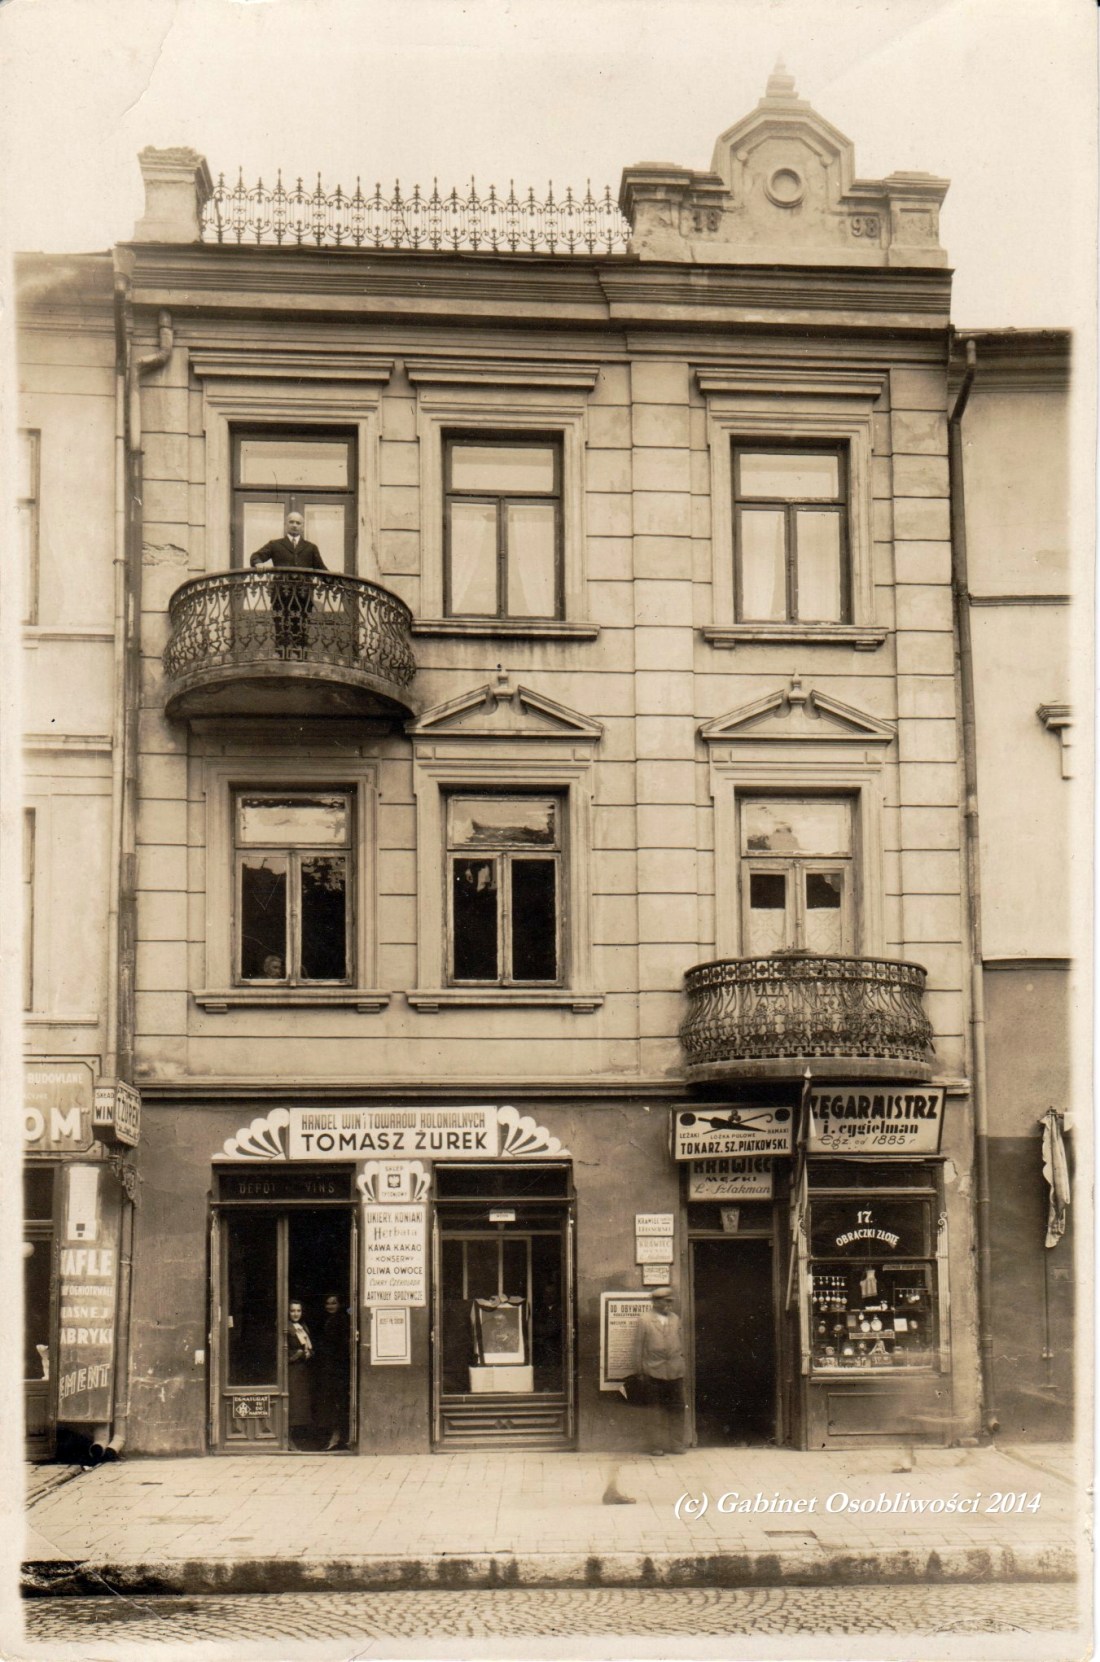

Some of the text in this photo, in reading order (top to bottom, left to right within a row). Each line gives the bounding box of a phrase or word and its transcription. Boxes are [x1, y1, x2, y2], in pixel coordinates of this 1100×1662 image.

[851, 216, 881, 239] 98
[95, 1105, 113, 1120] WIN
[808, 1095, 939, 1120] ZEGARMISTRZ
[302, 1113, 337, 1130] HANDEL
[342, 1113, 361, 1130] WIN
[420, 1112, 485, 1129] KOLONIALNYCH
[679, 1131, 700, 1139] LEŻAKI
[839, 1120, 919, 1138] cygielman
[301, 1130, 488, 1151] TOMASZ ŻUREK
[871, 1135, 907, 1146] 1885
[693, 1156, 771, 1174] KRAWIEC
[705, 1176, 757, 1184] MĘSKI
[305, 1182, 335, 1194] VINS
[395, 1211, 422, 1223] KONIAKI
[374, 1227, 417, 1240] Herbata
[835, 1228, 900, 1247] OBRĄCZKI ZŁOTE
[366, 1266, 423, 1275] OLIWA OWOCE
